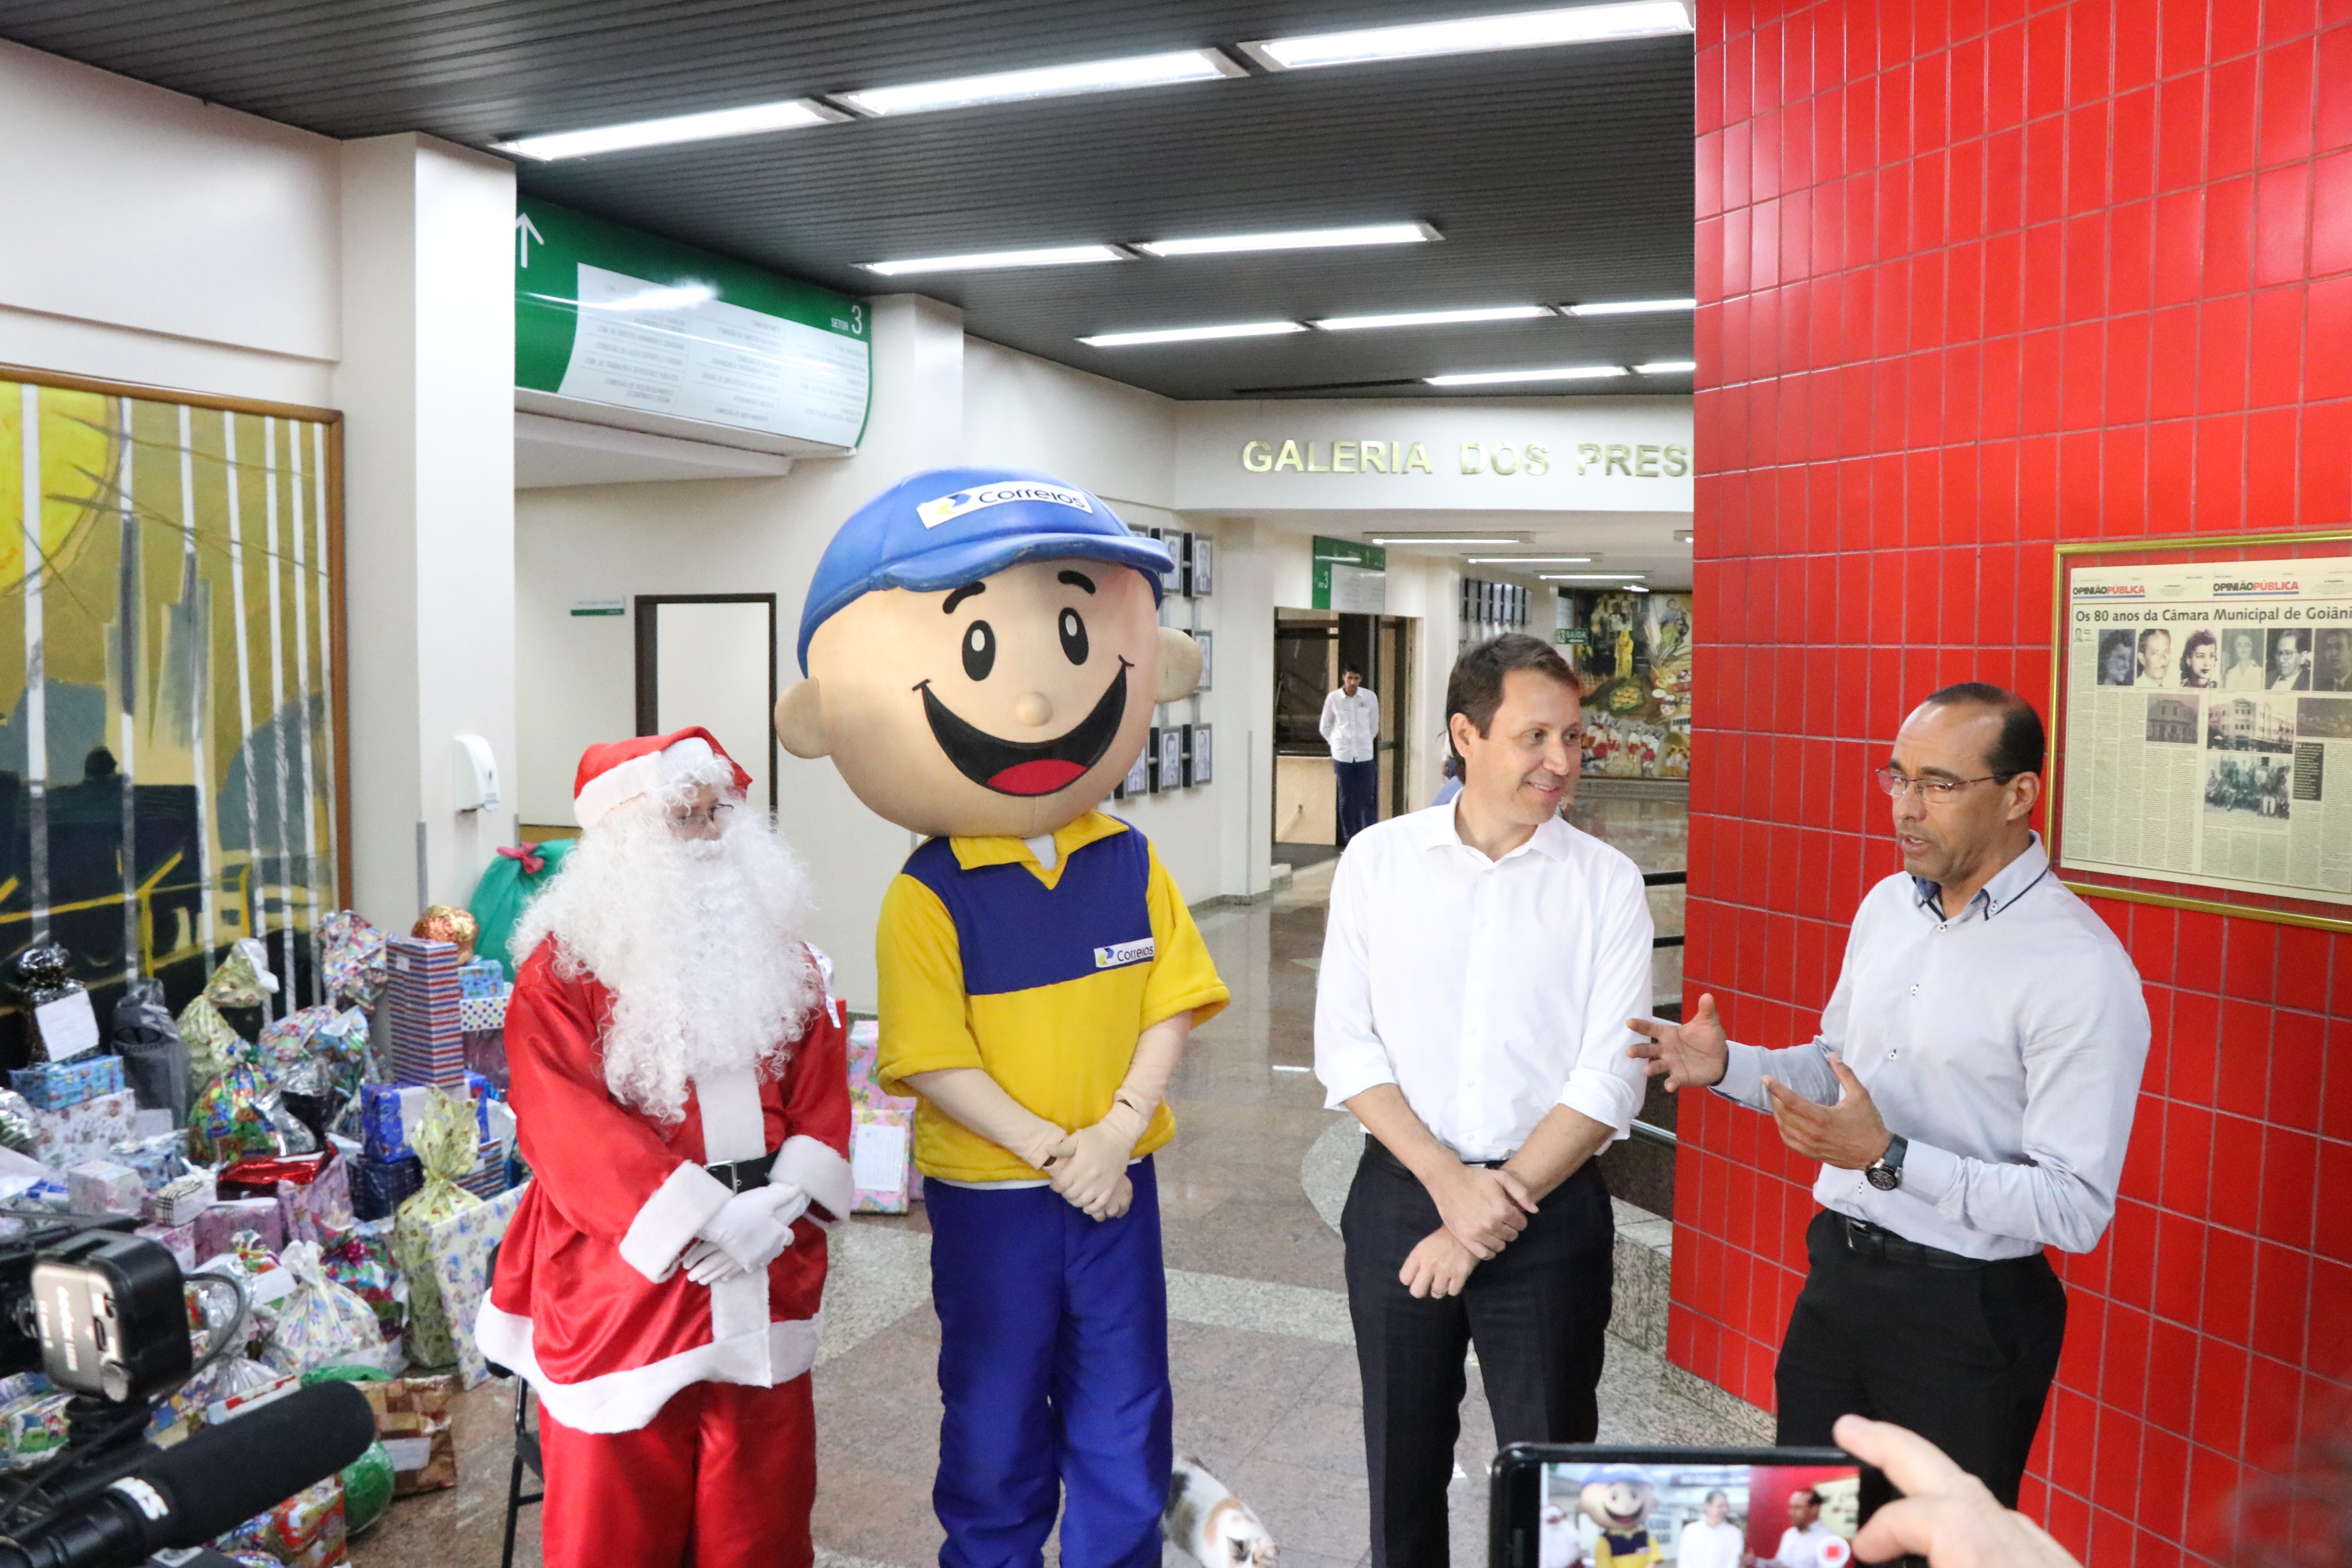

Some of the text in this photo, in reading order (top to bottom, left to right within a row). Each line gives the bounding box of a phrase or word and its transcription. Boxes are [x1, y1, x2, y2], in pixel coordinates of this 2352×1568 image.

[851, 304, 862, 335] 3
[1242, 438, 1694, 477] GALERIA DOS PRES
[978, 489, 1086, 509] Correios
[2075, 611, 2090, 622] Os
[2094, 610, 2109, 621] 80
[2113, 612, 2139, 621] anos
[2143, 609, 2158, 621] da
[2162, 609, 2209, 620] Câmara
[2214, 607, 2279, 624] Municipal
[2284, 606, 2301, 620] de
[1117, 946, 1154, 962] Correios
